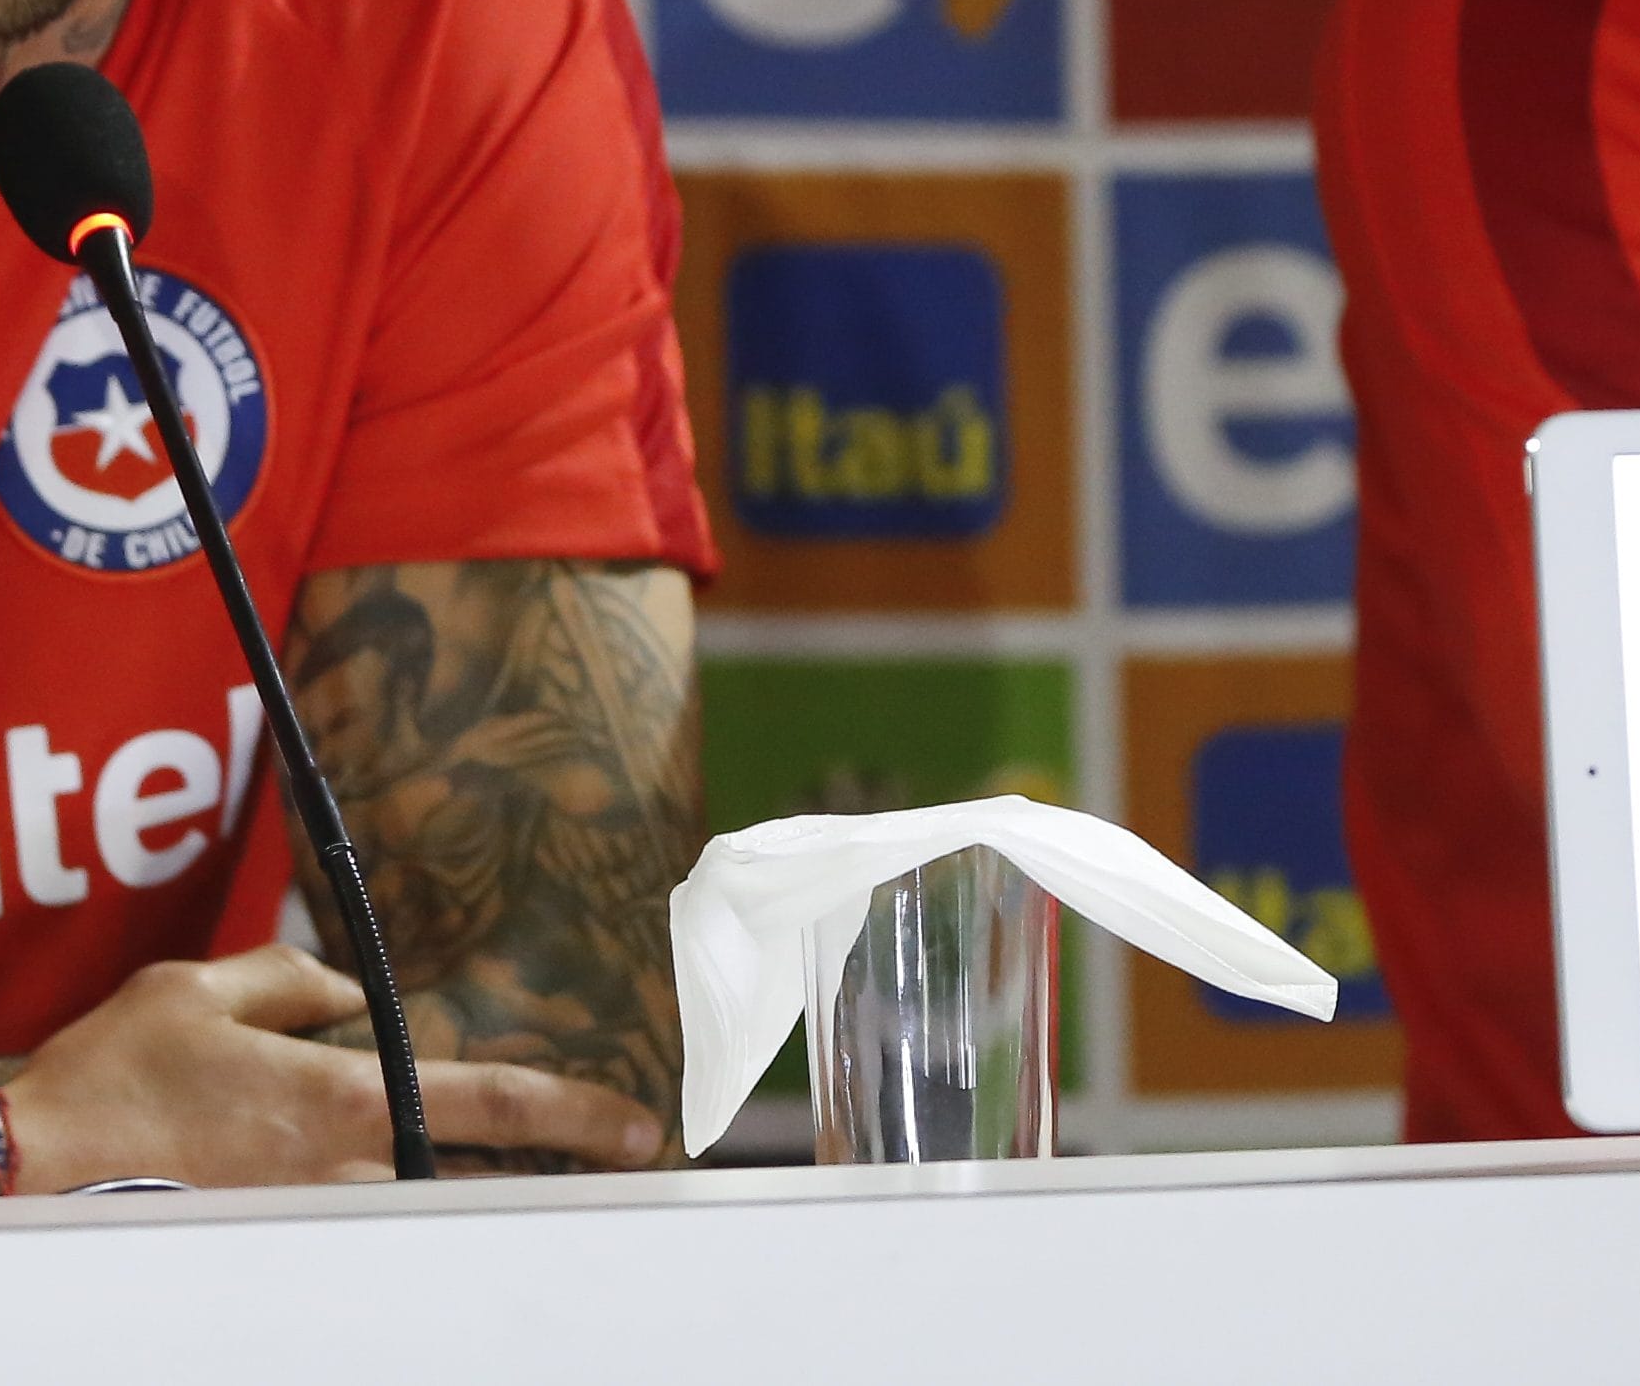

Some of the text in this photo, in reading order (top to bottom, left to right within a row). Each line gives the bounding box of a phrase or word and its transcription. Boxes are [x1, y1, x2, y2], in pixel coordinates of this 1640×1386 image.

[173, 289, 261, 405] FUTBOL
[741, 386, 995, 500] Itaú
[124, 517, 202, 571] CHIL
